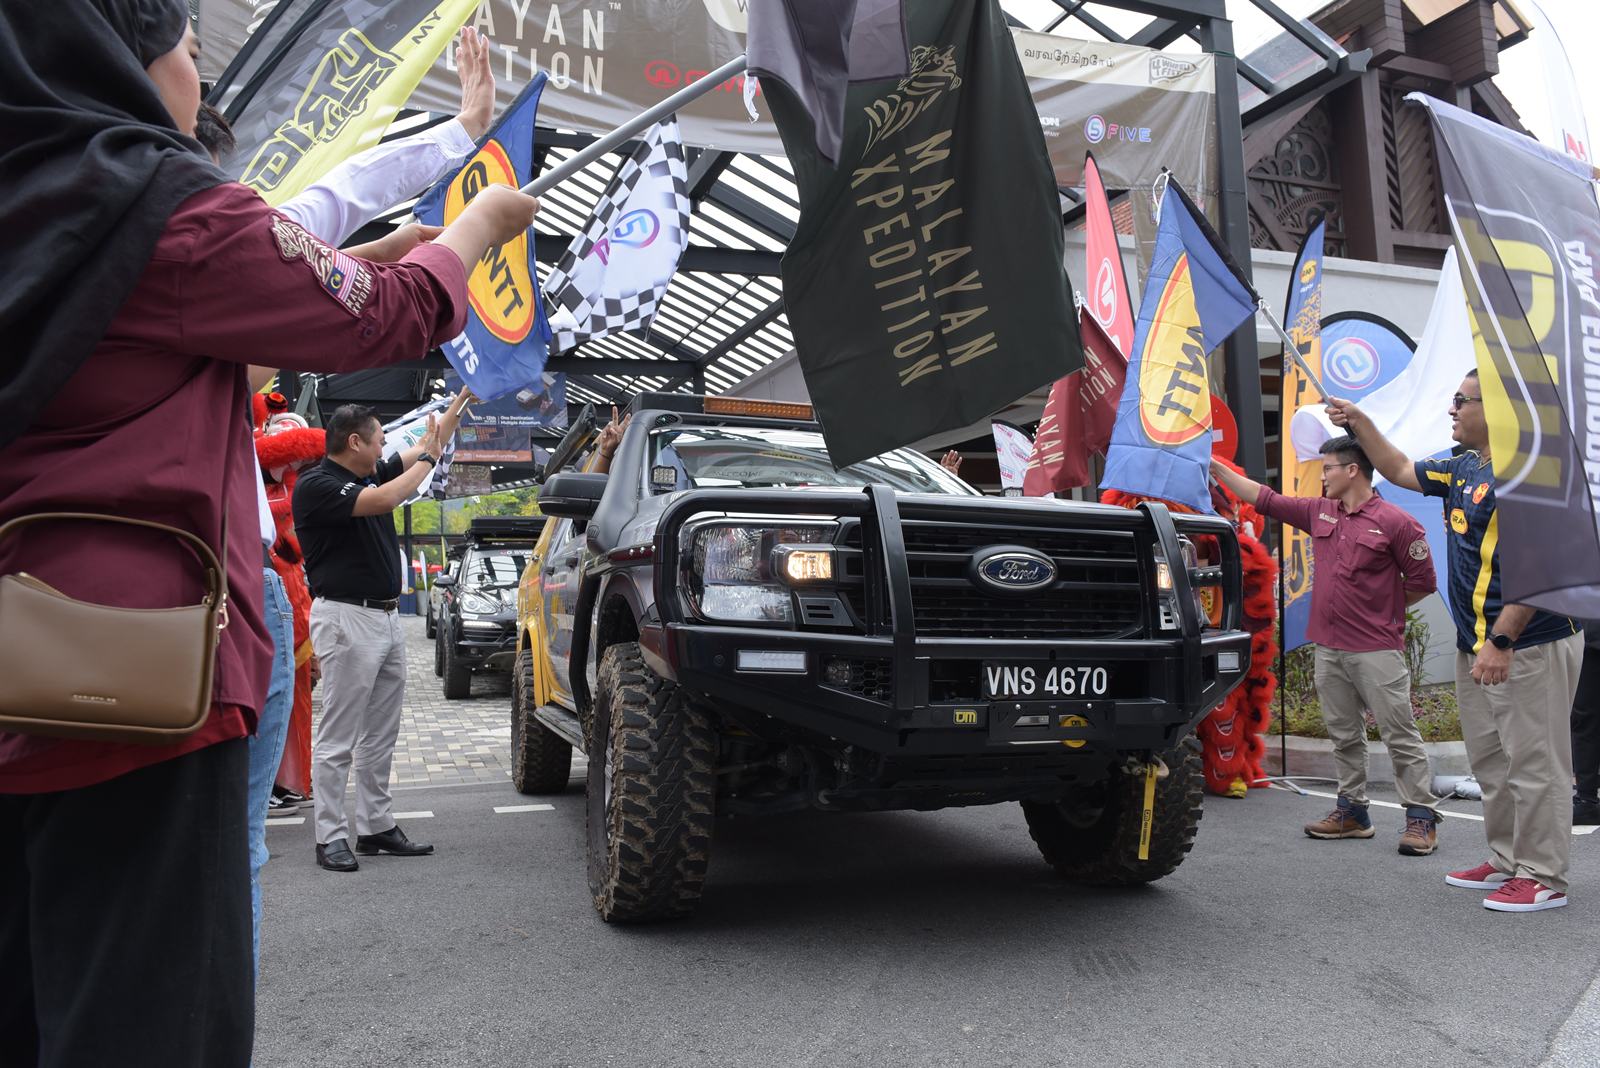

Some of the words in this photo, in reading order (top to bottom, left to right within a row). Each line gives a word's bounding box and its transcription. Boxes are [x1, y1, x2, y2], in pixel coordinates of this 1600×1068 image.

[411, 10, 441, 45] MY
[473, 0, 604, 51] AYAN
[1107, 123, 1152, 143] FIVE
[905, 129, 998, 367] MALAYAN
[851, 153, 943, 387] XPEDITION
[999, 560, 1039, 580] Ford
[987, 667, 1036, 695] VNS
[1044, 667, 1107, 695] 4670
